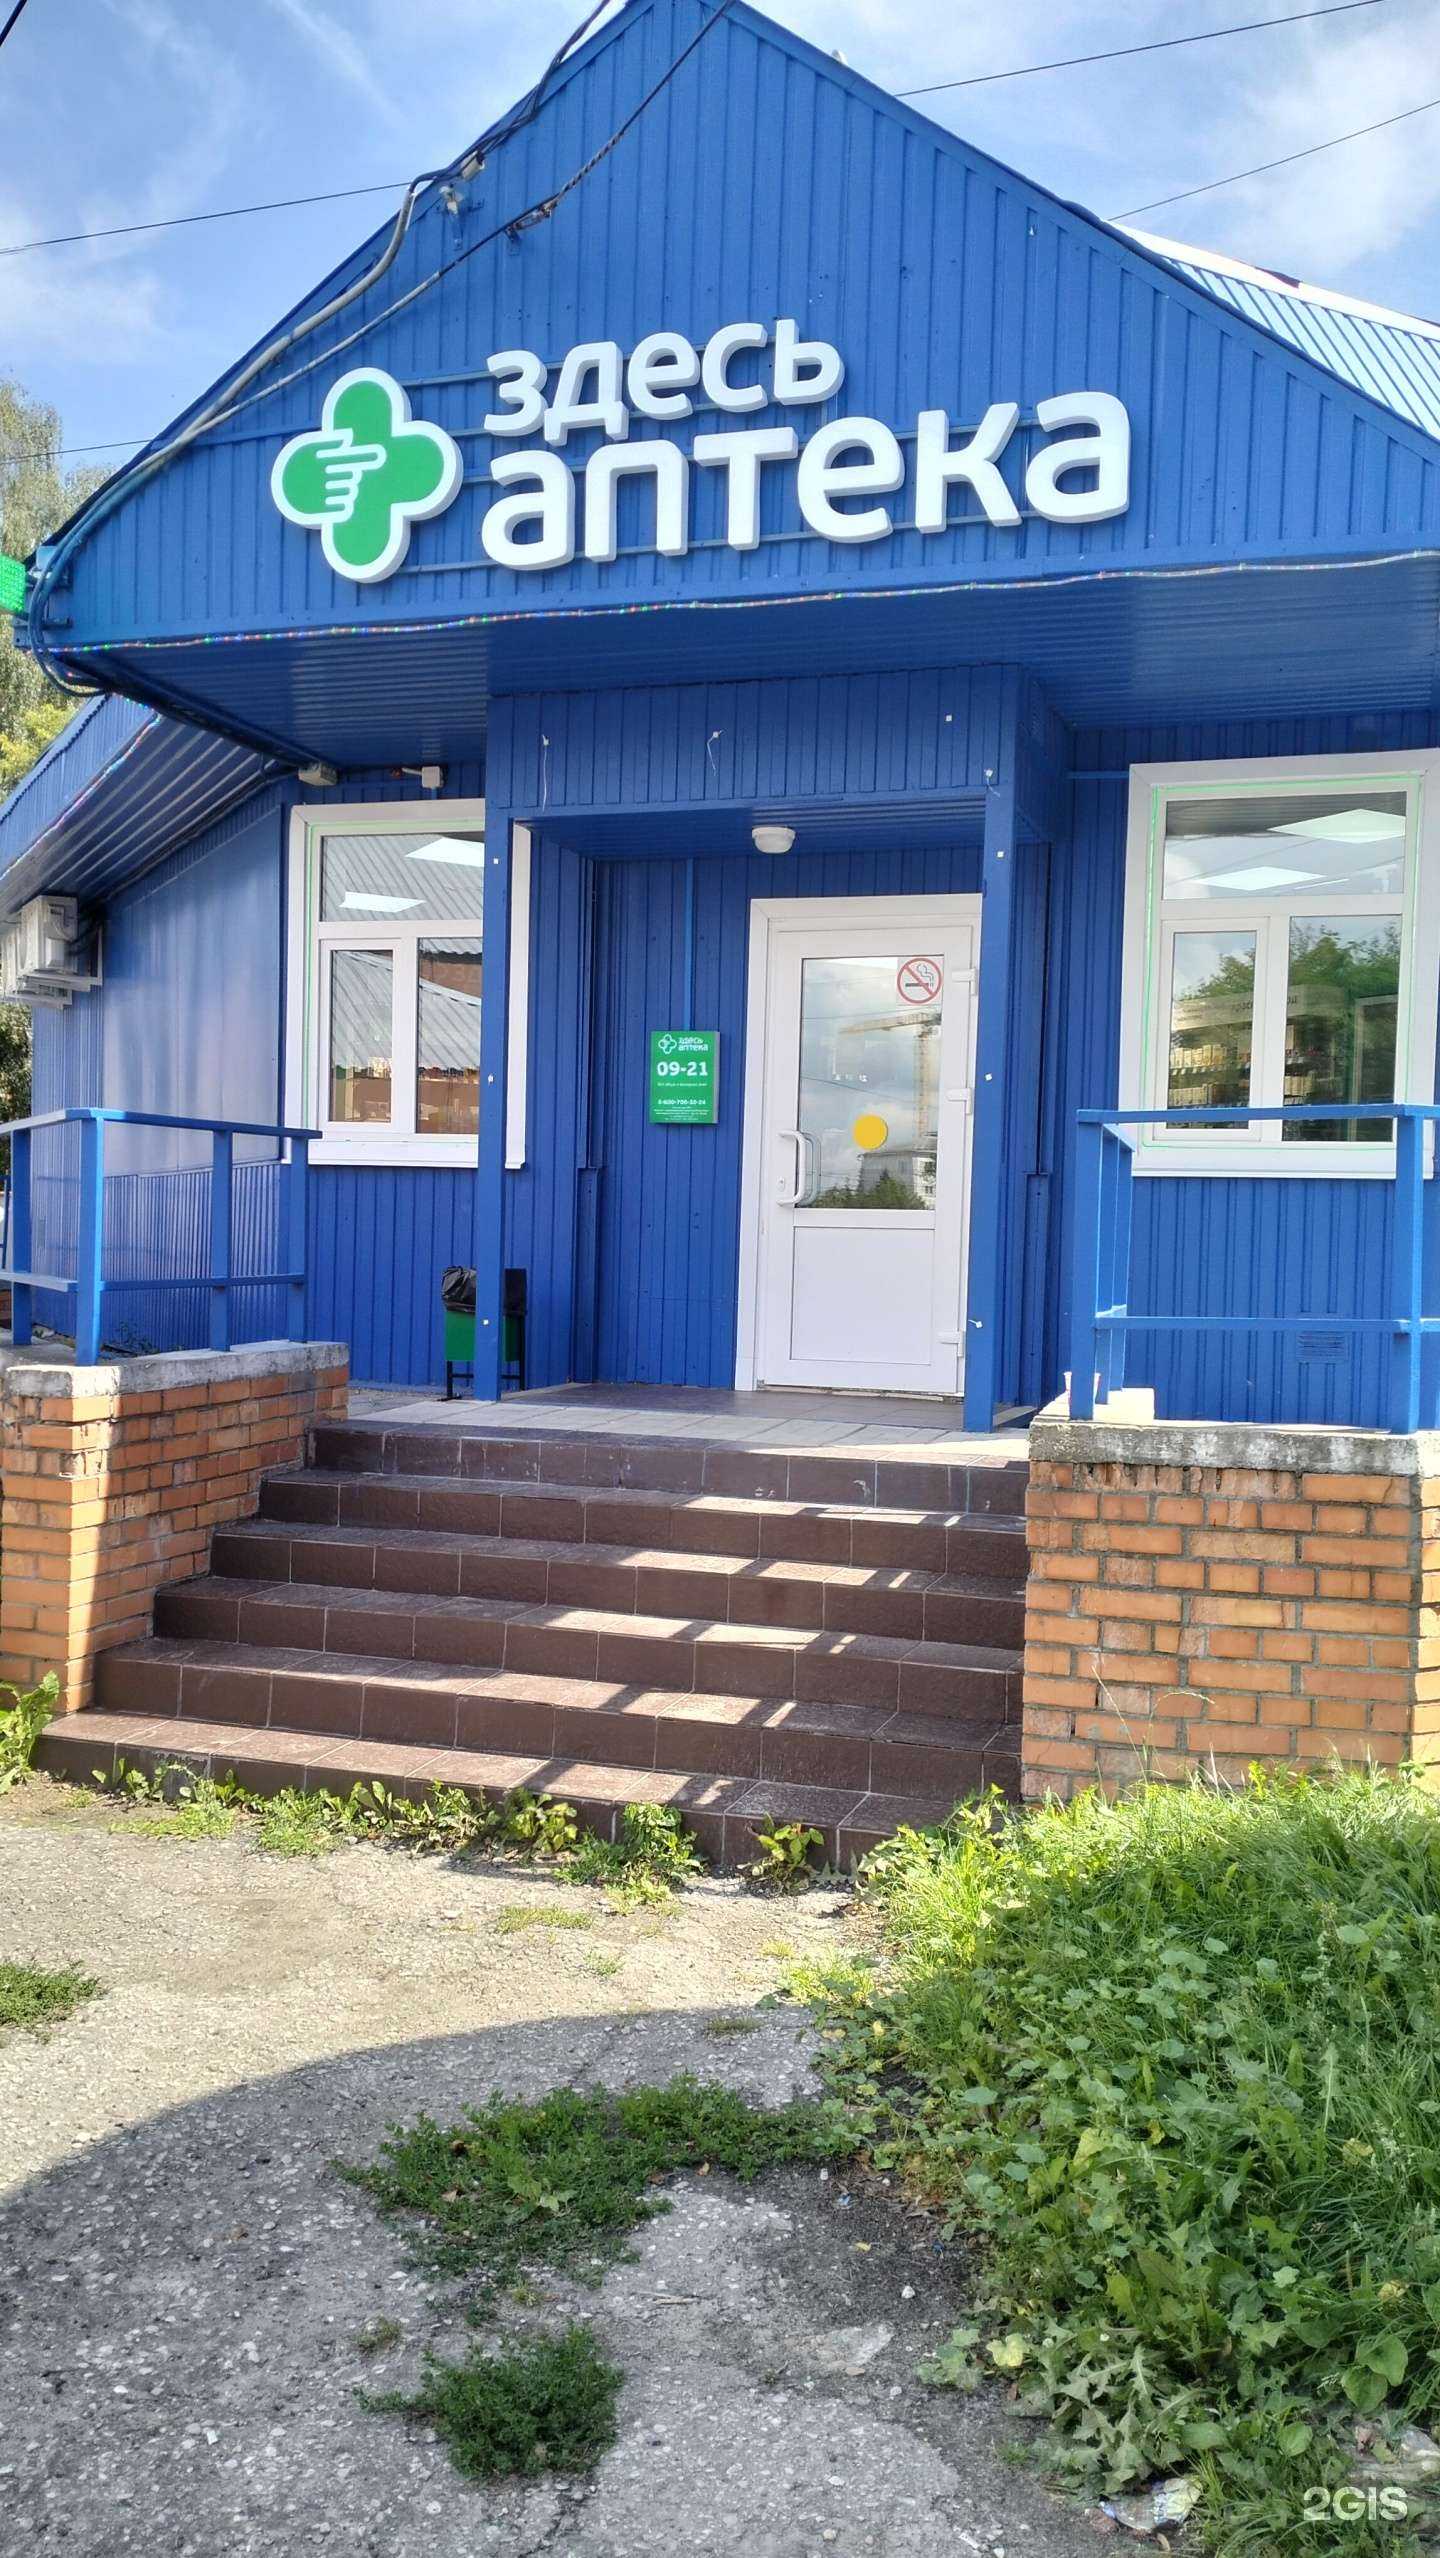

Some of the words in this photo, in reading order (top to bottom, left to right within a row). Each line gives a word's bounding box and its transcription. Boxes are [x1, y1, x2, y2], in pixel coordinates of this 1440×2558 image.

[483, 318, 845, 446] здесь
[481, 391, 1131, 571] аптека
[656, 1061, 708, 1076] 09-21
